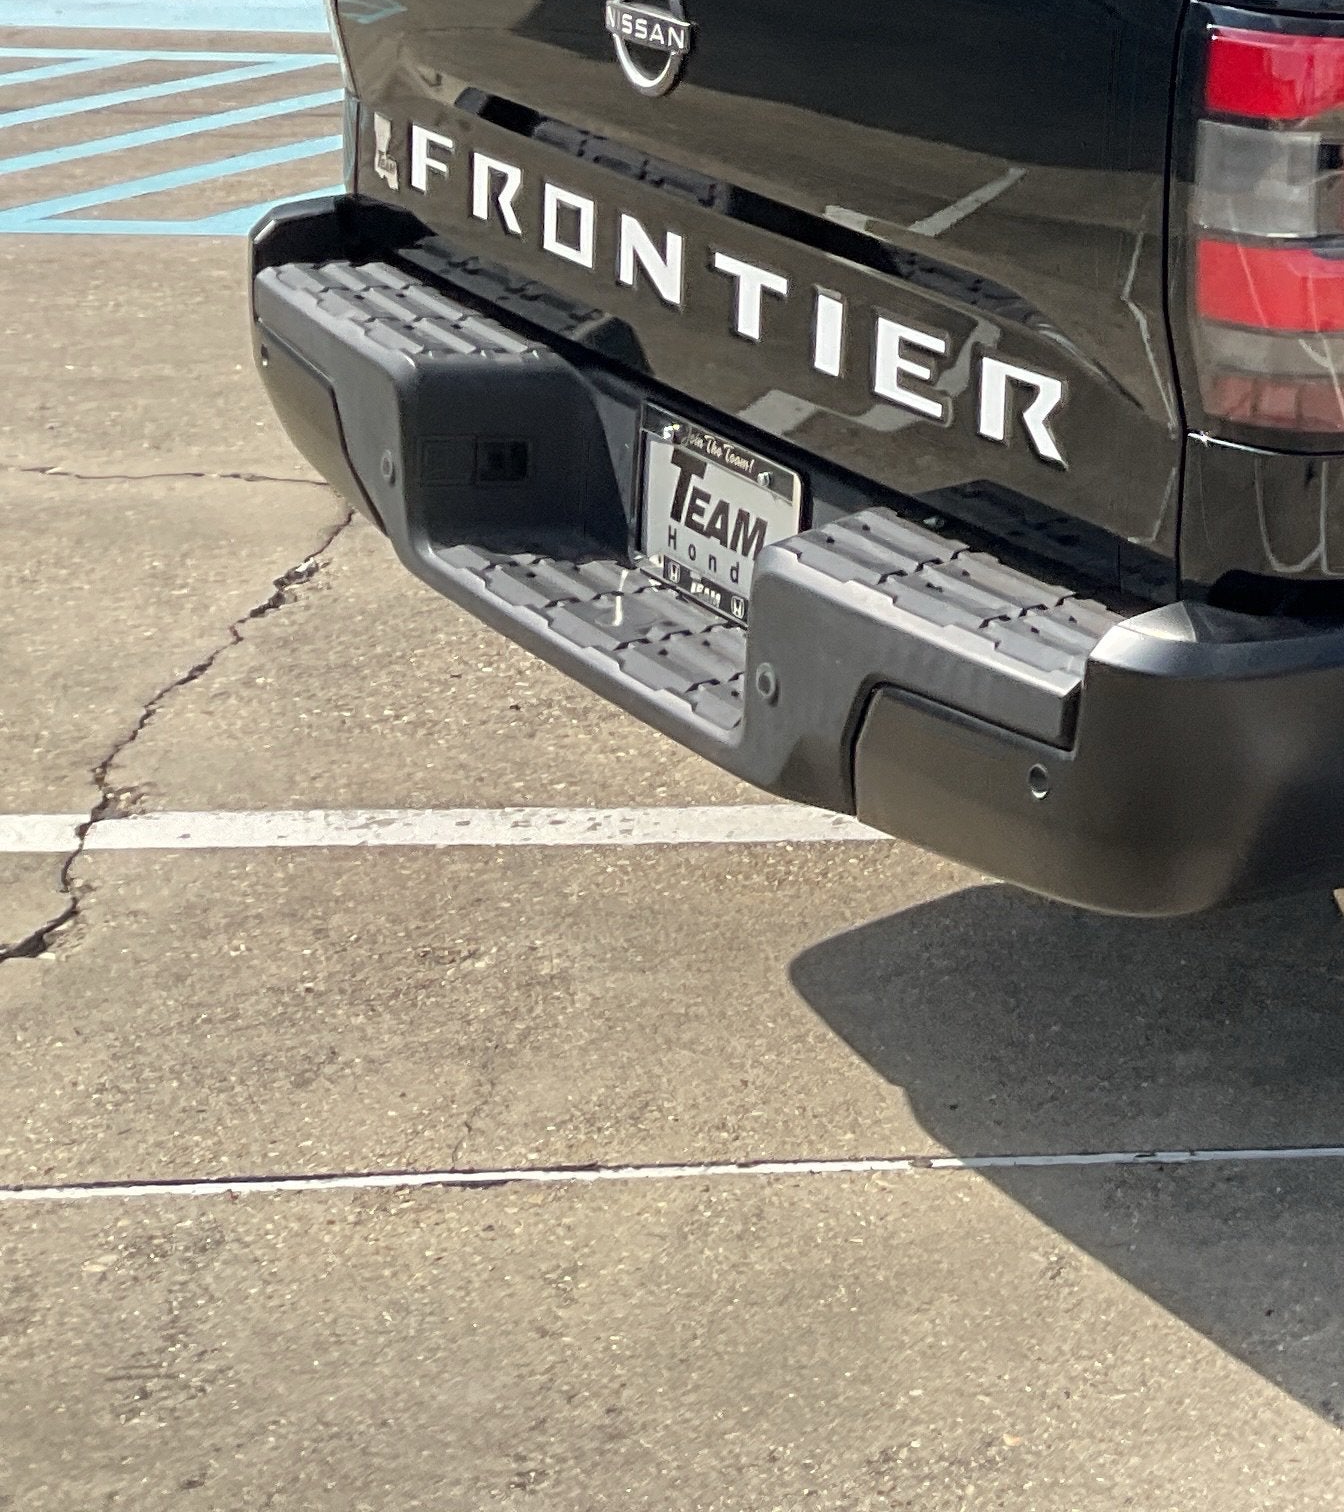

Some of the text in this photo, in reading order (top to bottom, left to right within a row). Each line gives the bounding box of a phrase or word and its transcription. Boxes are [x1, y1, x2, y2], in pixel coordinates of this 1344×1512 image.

[607, 5, 685, 49] NISSAN
[410, 121, 1069, 470] FRONTIER
[703, 434, 723, 458] The
[723, 443, 755, 474] Team!
[670, 448, 768, 561] TEAM
[667, 524, 740, 585] Hond
